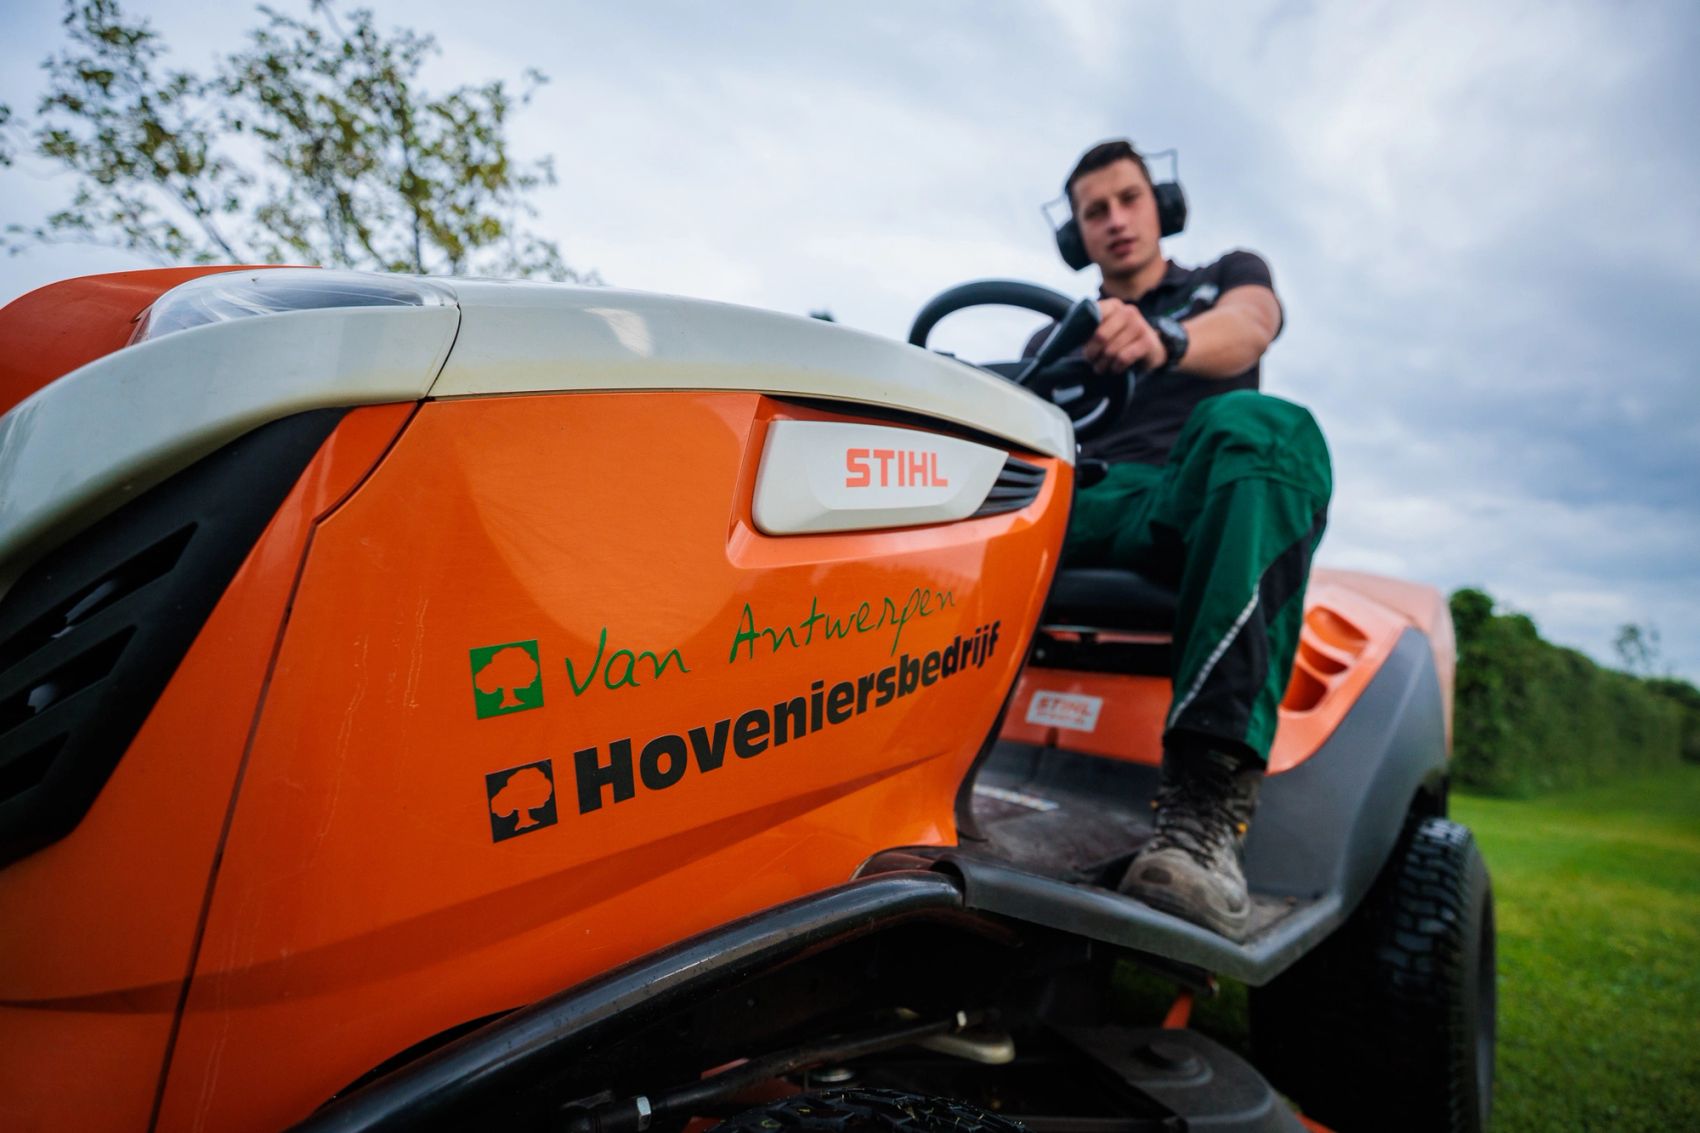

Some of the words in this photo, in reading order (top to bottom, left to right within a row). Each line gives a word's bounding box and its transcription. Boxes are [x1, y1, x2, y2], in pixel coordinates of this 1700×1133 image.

[846, 448, 948, 487] STIHL
[566, 628, 692, 697] Van
[729, 587, 955, 663] Antwerpen
[574, 621, 1000, 814] Hoveniersbedrijf
